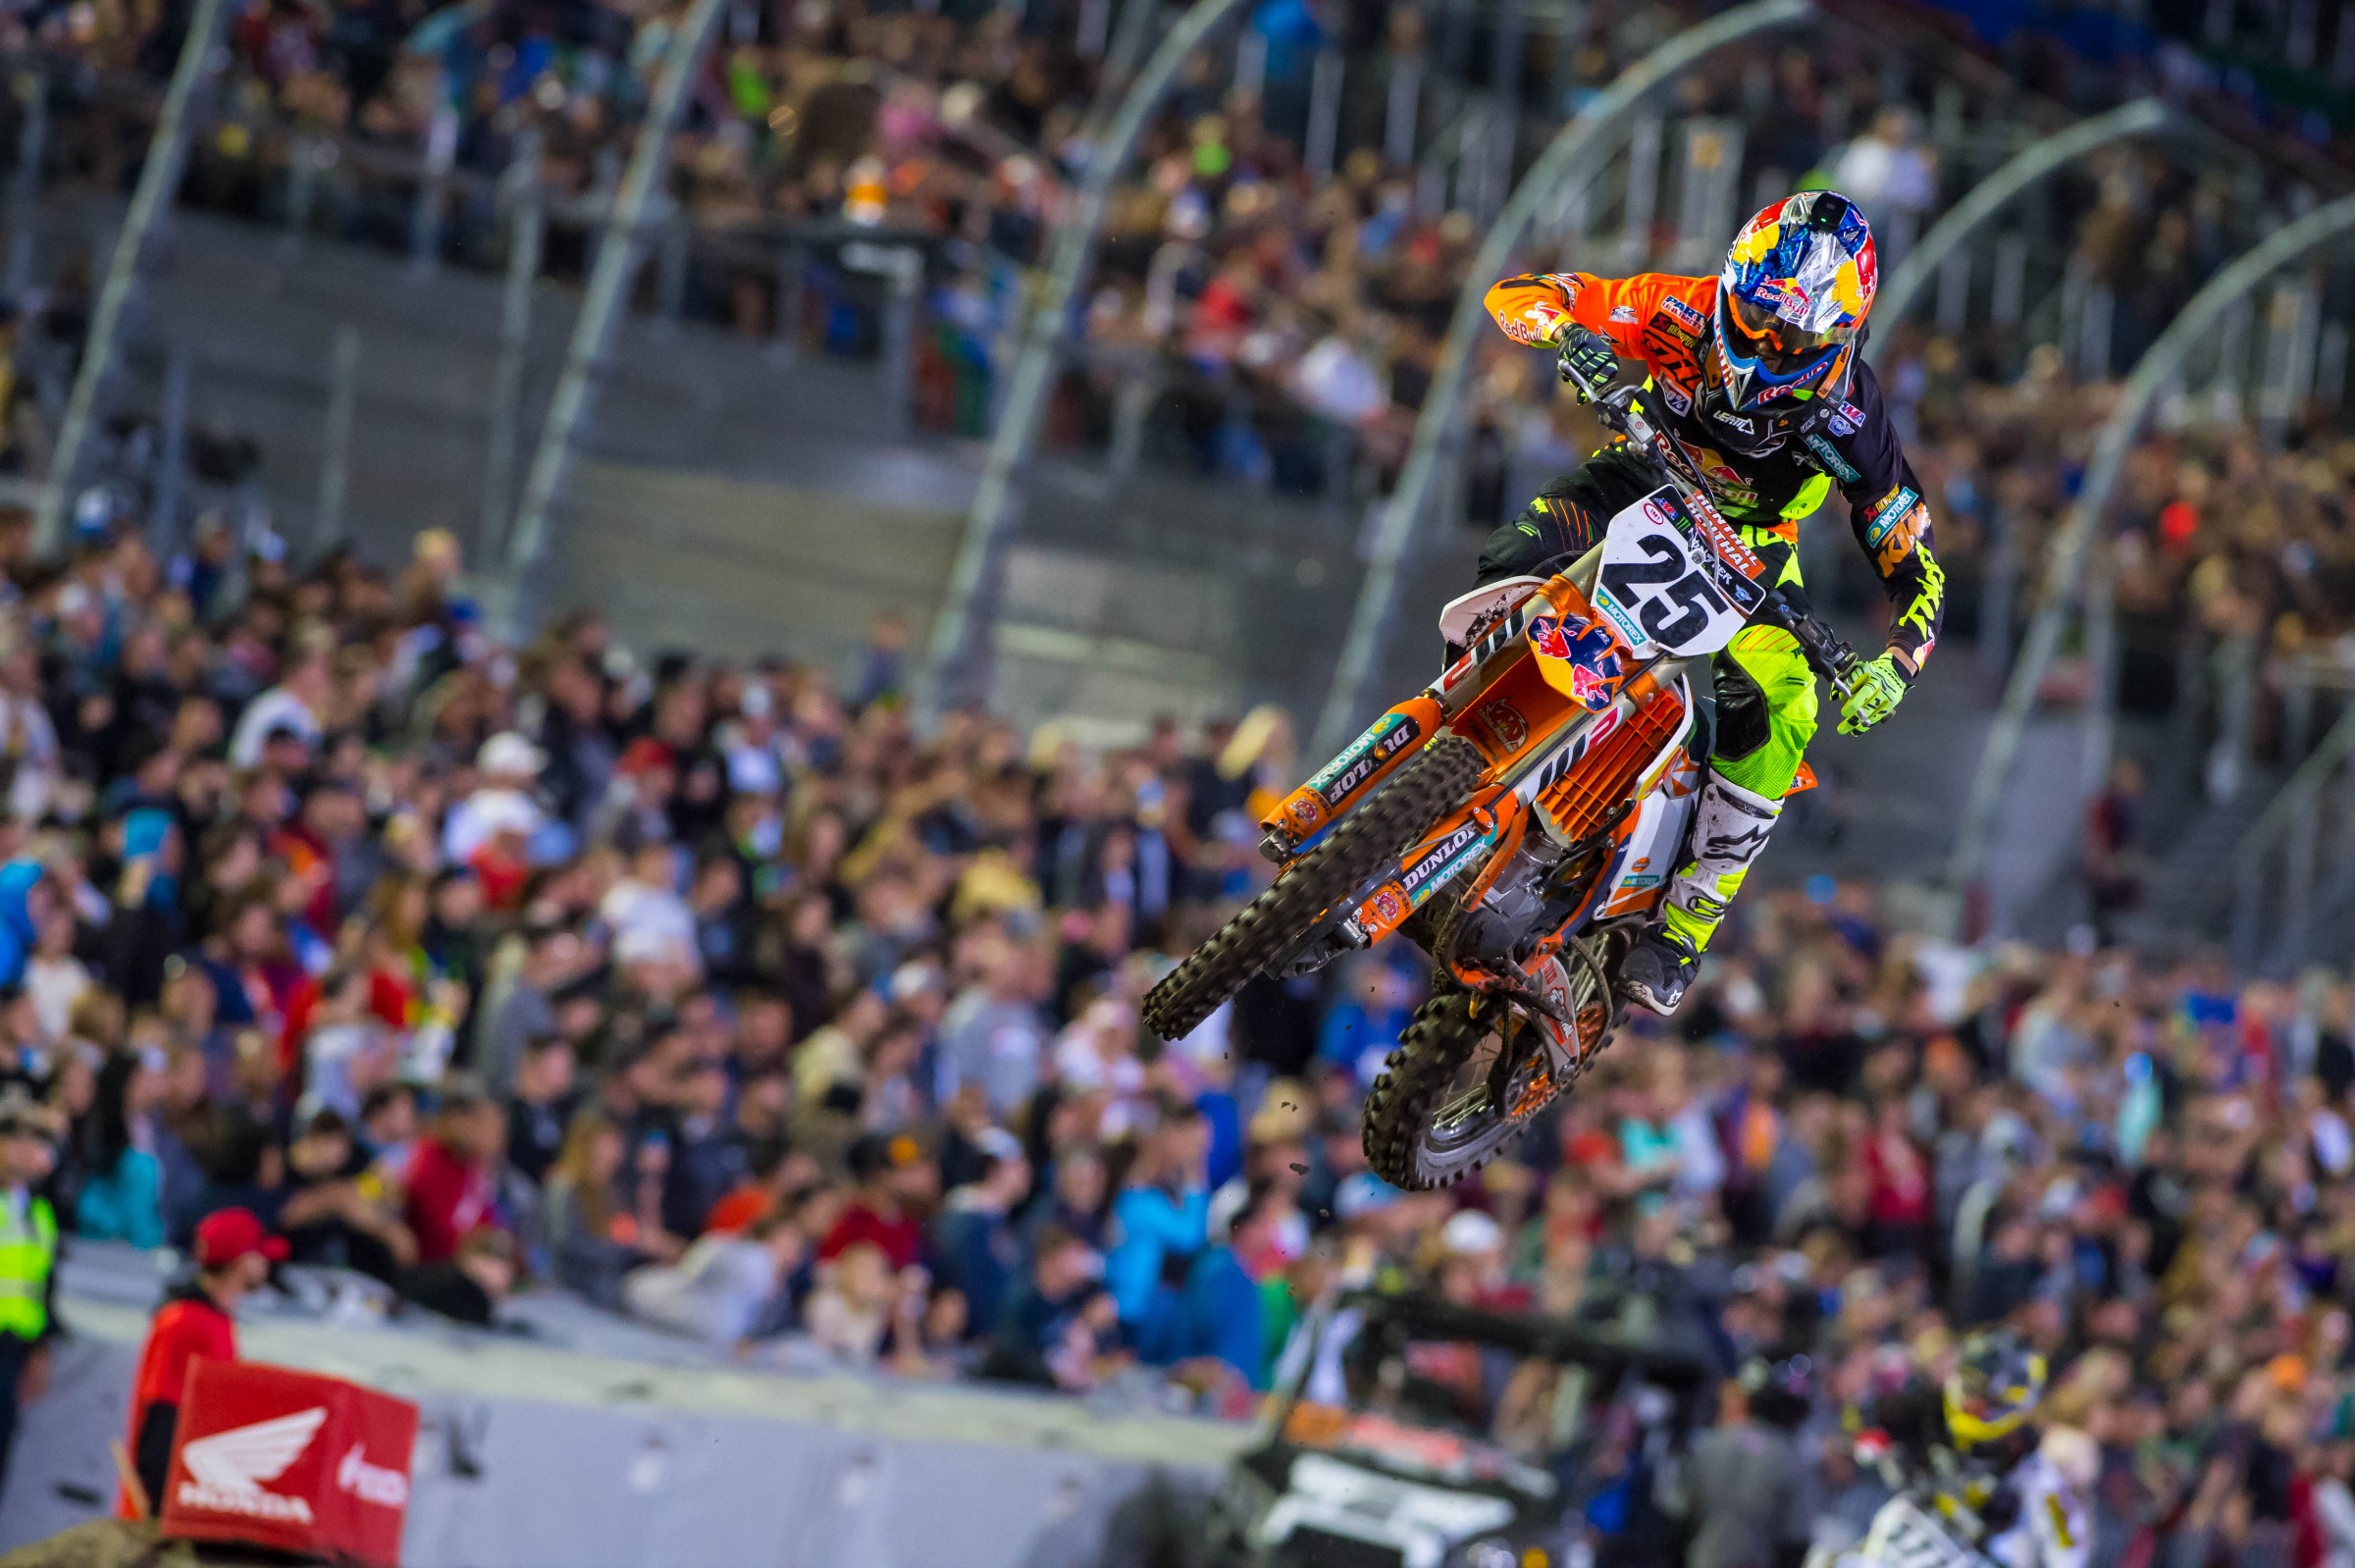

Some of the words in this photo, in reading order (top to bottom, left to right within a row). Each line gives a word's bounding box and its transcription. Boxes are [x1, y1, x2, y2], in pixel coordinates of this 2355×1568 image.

[1498, 310, 1520, 339] Red
[1519, 321, 1544, 342] Bull
[1756, 287, 1784, 302] Red
[1784, 293, 1808, 315] Bull
[1696, 493, 1758, 567] RENTHAL
[1878, 491, 1913, 530] MOTOREX
[1877, 502, 1932, 579] KTM
[1600, 534, 1730, 650] 25
[1606, 602, 1643, 645] MOTOREX
[1309, 732, 1377, 788] MOTOREX
[1429, 838, 1488, 891] MOTOREX
